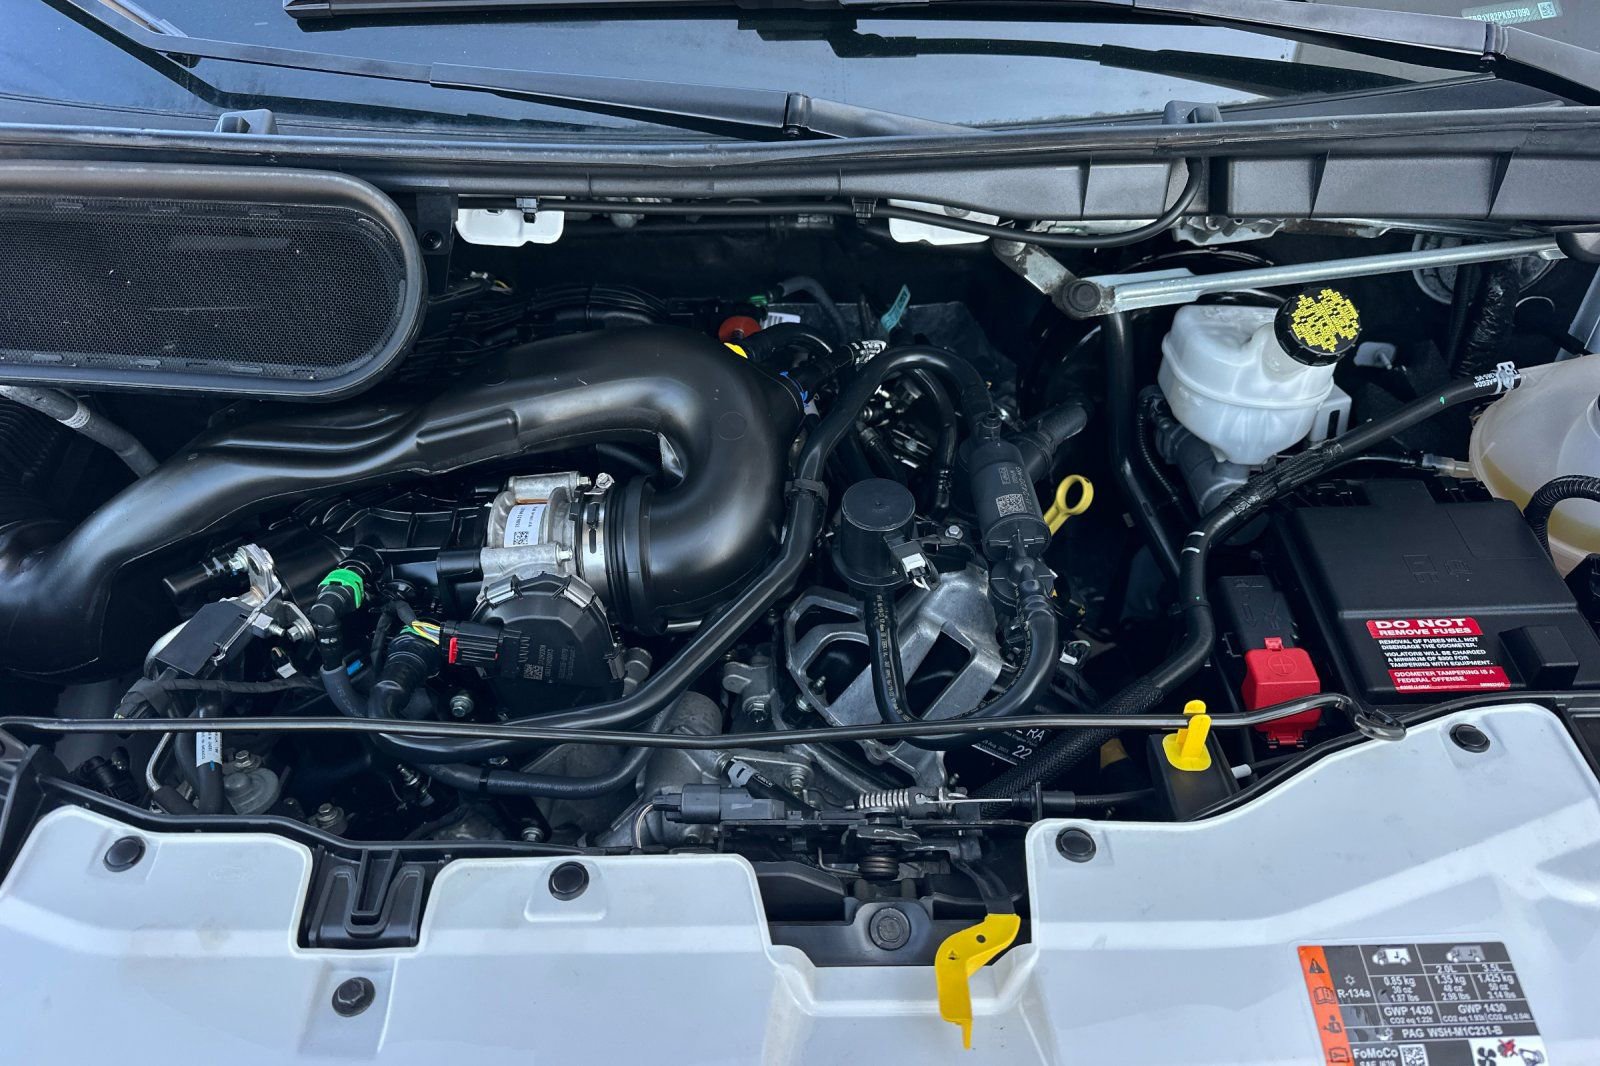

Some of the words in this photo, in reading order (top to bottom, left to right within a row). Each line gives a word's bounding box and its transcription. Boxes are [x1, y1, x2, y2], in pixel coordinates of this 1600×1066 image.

[1375, 620, 1410, 629] DO
[1417, 618, 1466, 627] NOT
[1432, 627, 1472, 635] FUSES
[1012, 744, 1033, 759] 22
[1436, 965, 1457, 973] 2.0L
[1482, 963, 1503, 972] 3.5L
[1383, 977, 1403, 986] 0.85
[1403, 976, 1416, 987] kg
[1434, 974, 1453, 984] 1.35
[1453, 973, 1467, 986] kg
[1477, 973, 1501, 983] 1.425
[1501, 972, 1515, 984] kg
[1337, 989, 1371, 998] R-134a
[1392, 986, 1402, 994] 30
[1407, 994, 1420, 1002] lbs
[1459, 992, 1471, 1000] lbs
[1384, 1006, 1408, 1016] GWP
[1410, 1005, 1434, 1015] 1430
[1457, 1004, 1482, 1014] GWP
[1483, 1003, 1507, 1013] 1430
[1459, 1016, 1468, 1024] eq
[1504, 1014, 1513, 1022] eq
[1402, 1028, 1425, 1038] PAG
[1427, 1025, 1503, 1038] WSH-M1C231-B
[1352, 1047, 1399, 1059] FoMoCo
